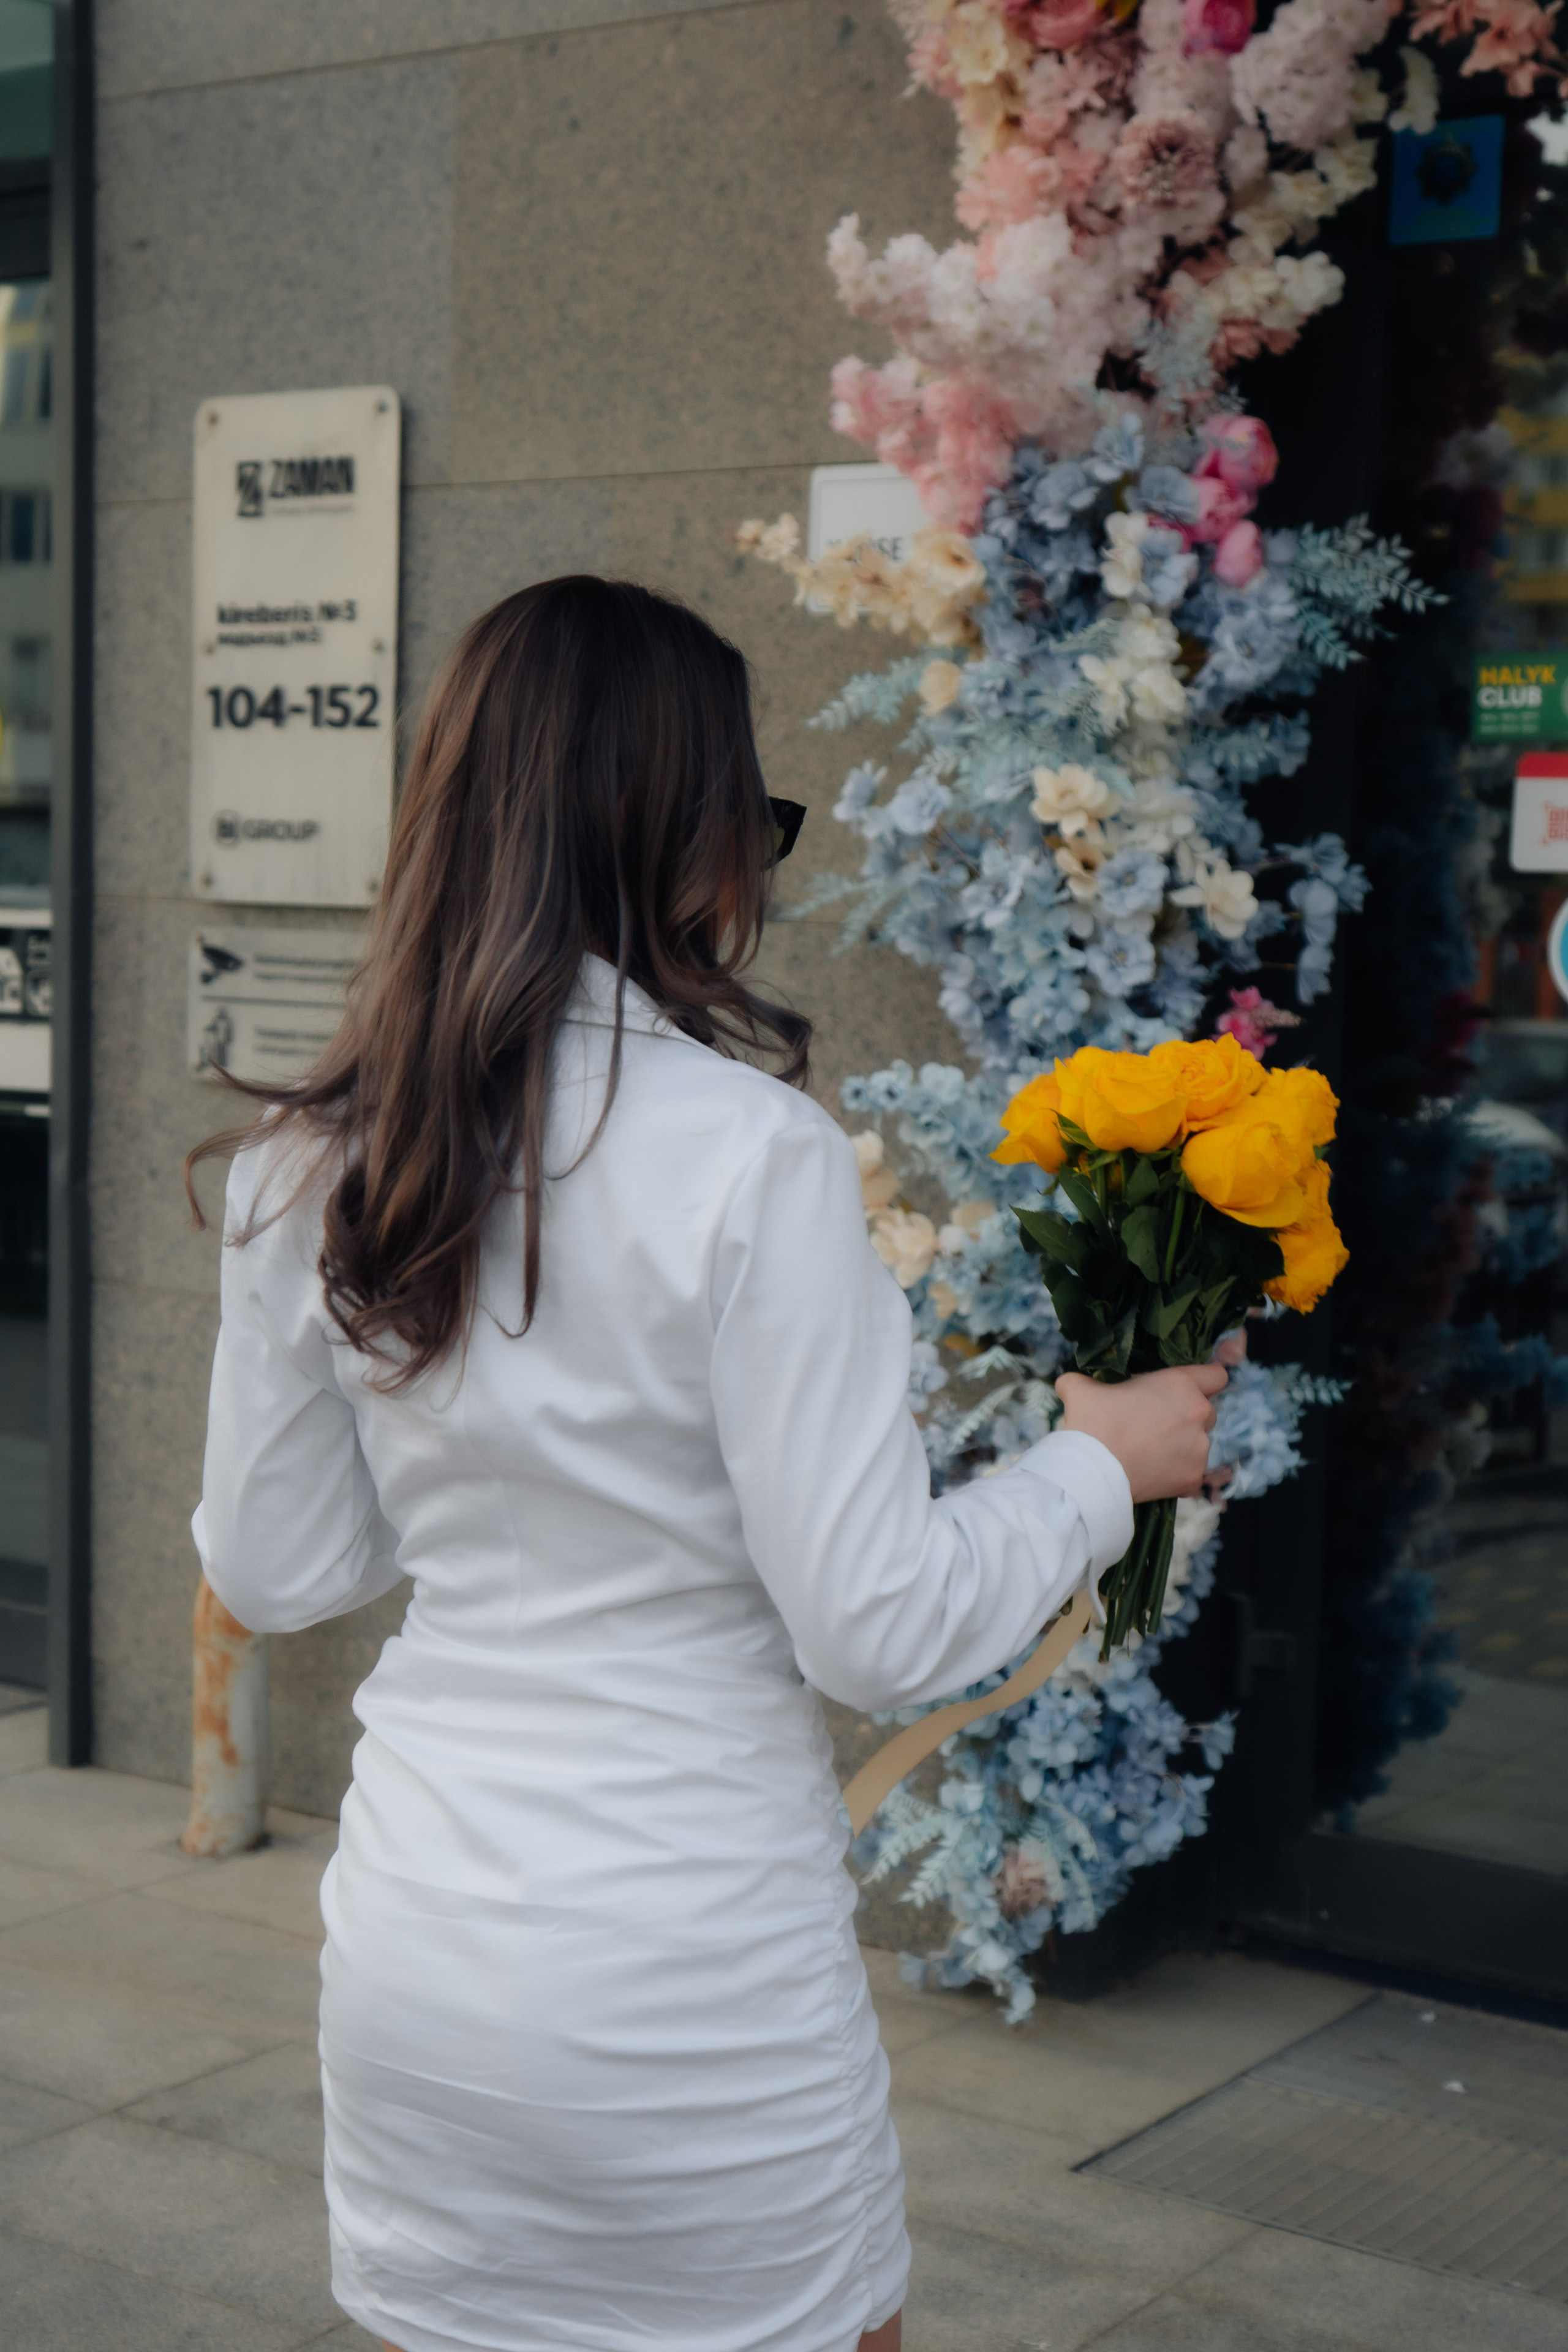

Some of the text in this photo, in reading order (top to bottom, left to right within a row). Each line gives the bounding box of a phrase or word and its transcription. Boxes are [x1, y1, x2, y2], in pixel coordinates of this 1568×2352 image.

[269, 455, 355, 497] ZAMAN
[1479, 665, 1556, 685] HALYK
[207, 684, 380, 728] 104-152
[1477, 685, 1542, 709] CLUB
[243, 818, 320, 841] GROUP
